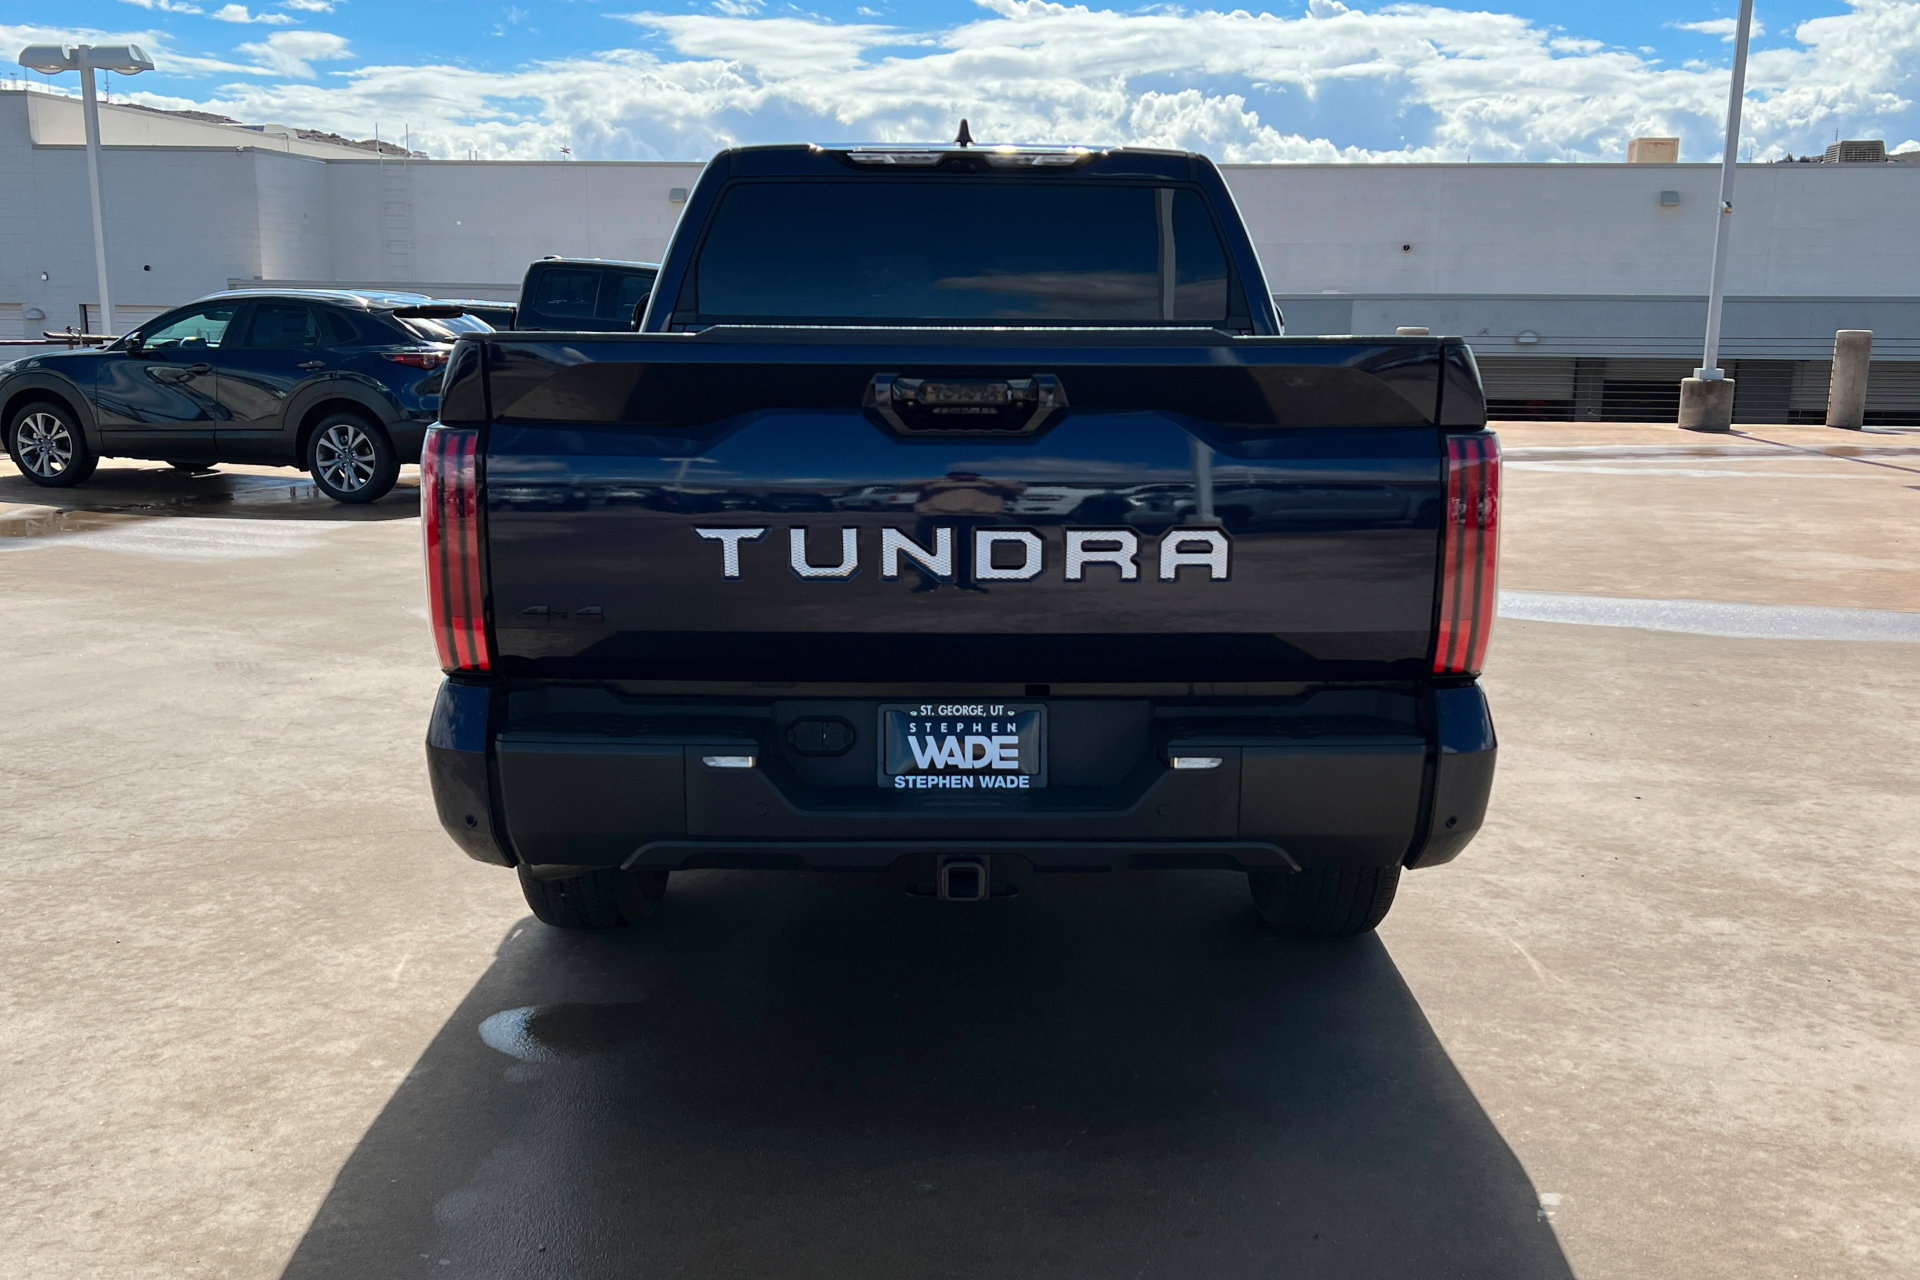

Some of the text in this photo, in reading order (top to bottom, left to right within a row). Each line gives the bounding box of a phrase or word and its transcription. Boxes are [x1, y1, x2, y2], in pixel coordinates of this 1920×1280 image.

[694, 526, 1232, 582] TUNDRA
[920, 705, 1004, 717] ST. GEORGE, UT
[909, 722, 1016, 733] STEPHEN
[907, 735, 1019, 769] WADE
[894, 775, 1030, 789] STEPHEN WADE
